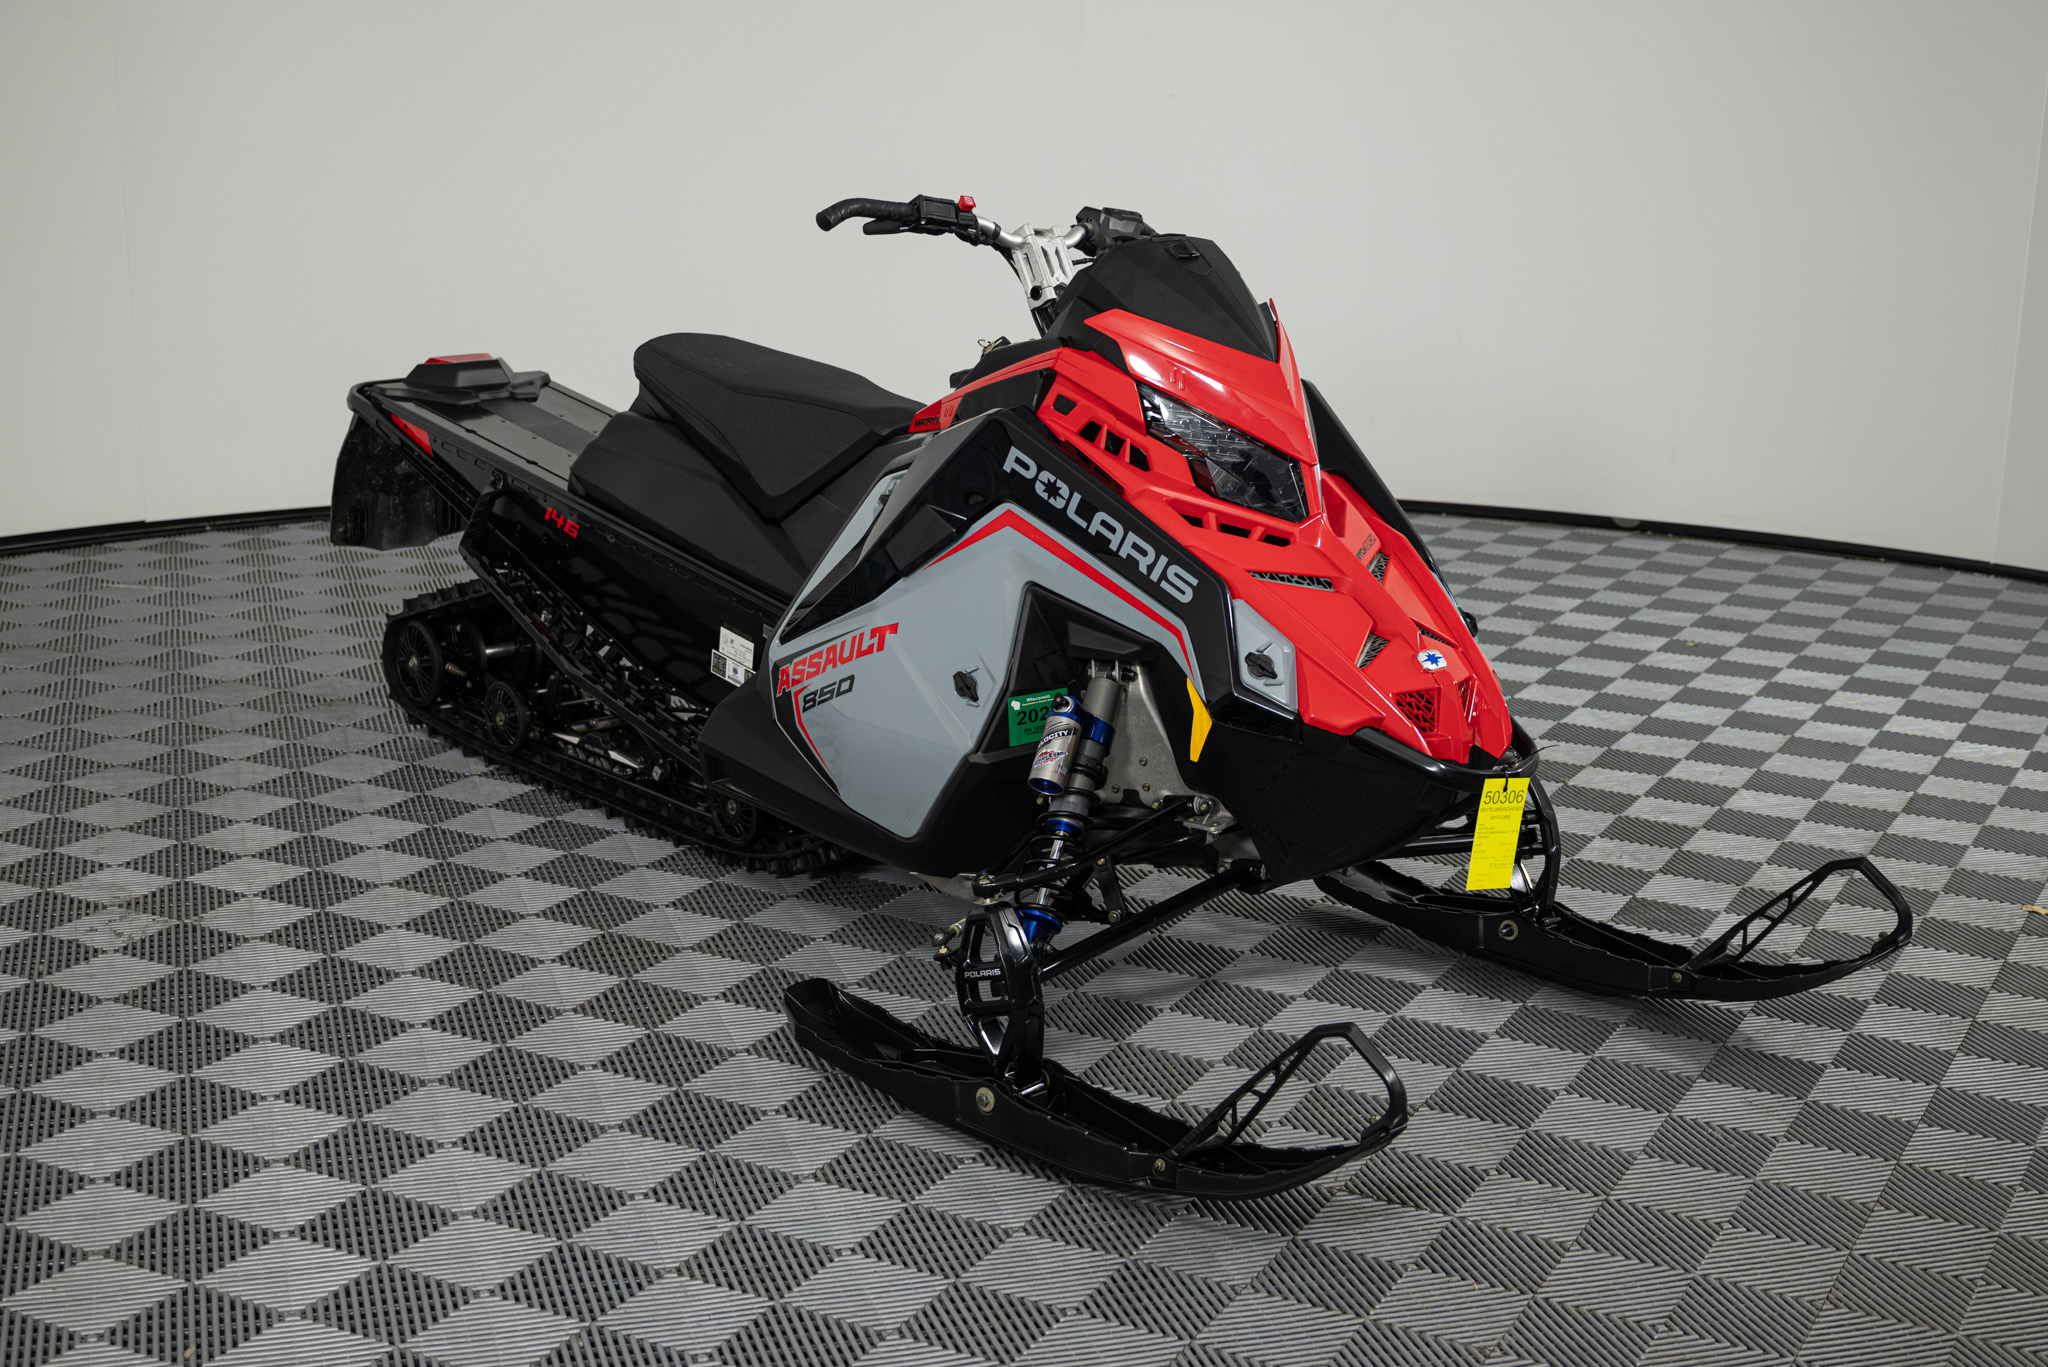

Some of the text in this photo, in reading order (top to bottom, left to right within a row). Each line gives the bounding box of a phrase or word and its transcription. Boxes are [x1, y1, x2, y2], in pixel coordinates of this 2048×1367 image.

[914, 415, 942, 429] MATRYX
[544, 506, 580, 539] 146
[1002, 445, 1199, 604] POLARIS
[776, 622, 899, 696] ASSAULT
[802, 673, 855, 714] 850
[1026, 694, 1051, 703] Wisconsin
[1017, 706, 1050, 726] 202
[1039, 729, 1069, 746] LOCITY
[1483, 789, 1525, 805] 50306
[964, 968, 1001, 978] POLARIS
